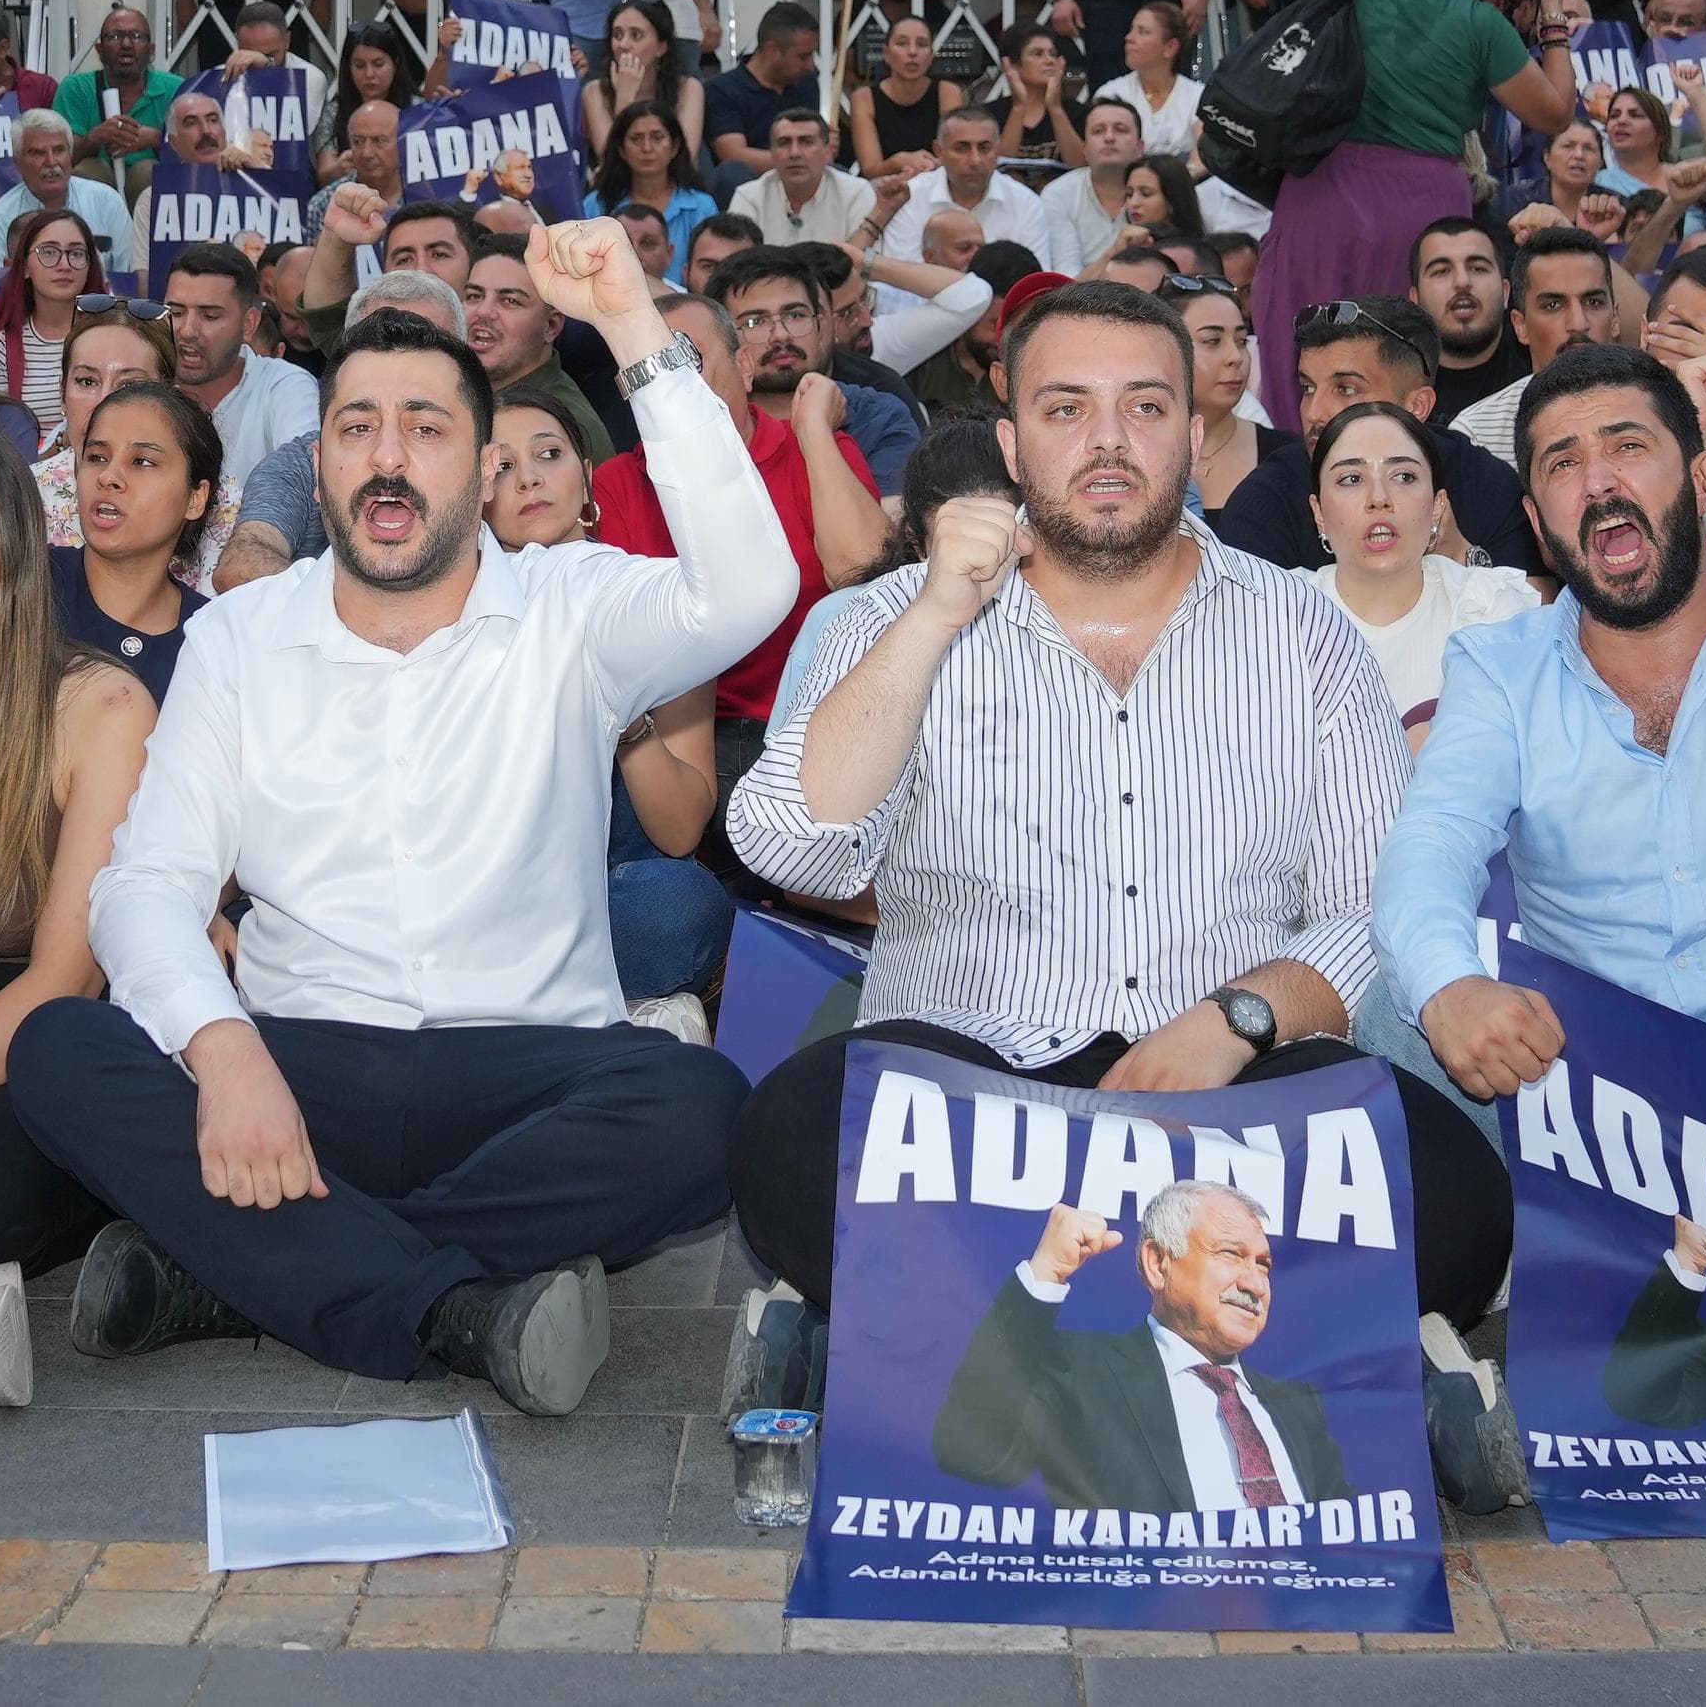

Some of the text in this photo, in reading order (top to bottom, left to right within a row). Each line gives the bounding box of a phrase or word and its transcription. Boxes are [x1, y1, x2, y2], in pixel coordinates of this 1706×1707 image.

[452, 18, 579, 79] ADANA
[406, 103, 569, 184] ADANA
[153, 193, 303, 243] ADANA
[855, 1069, 1397, 1250] ADANA
[830, 1489, 1416, 1549] ZEYDAN KARALAR'DIR
[1580, 1485, 1701, 1501] Adanalı
[849, 1564, 1396, 1590] Adanalı haksızlığa boyun eğmez.
[927, 1550, 1317, 1574] Adana tutsak edilemez,
